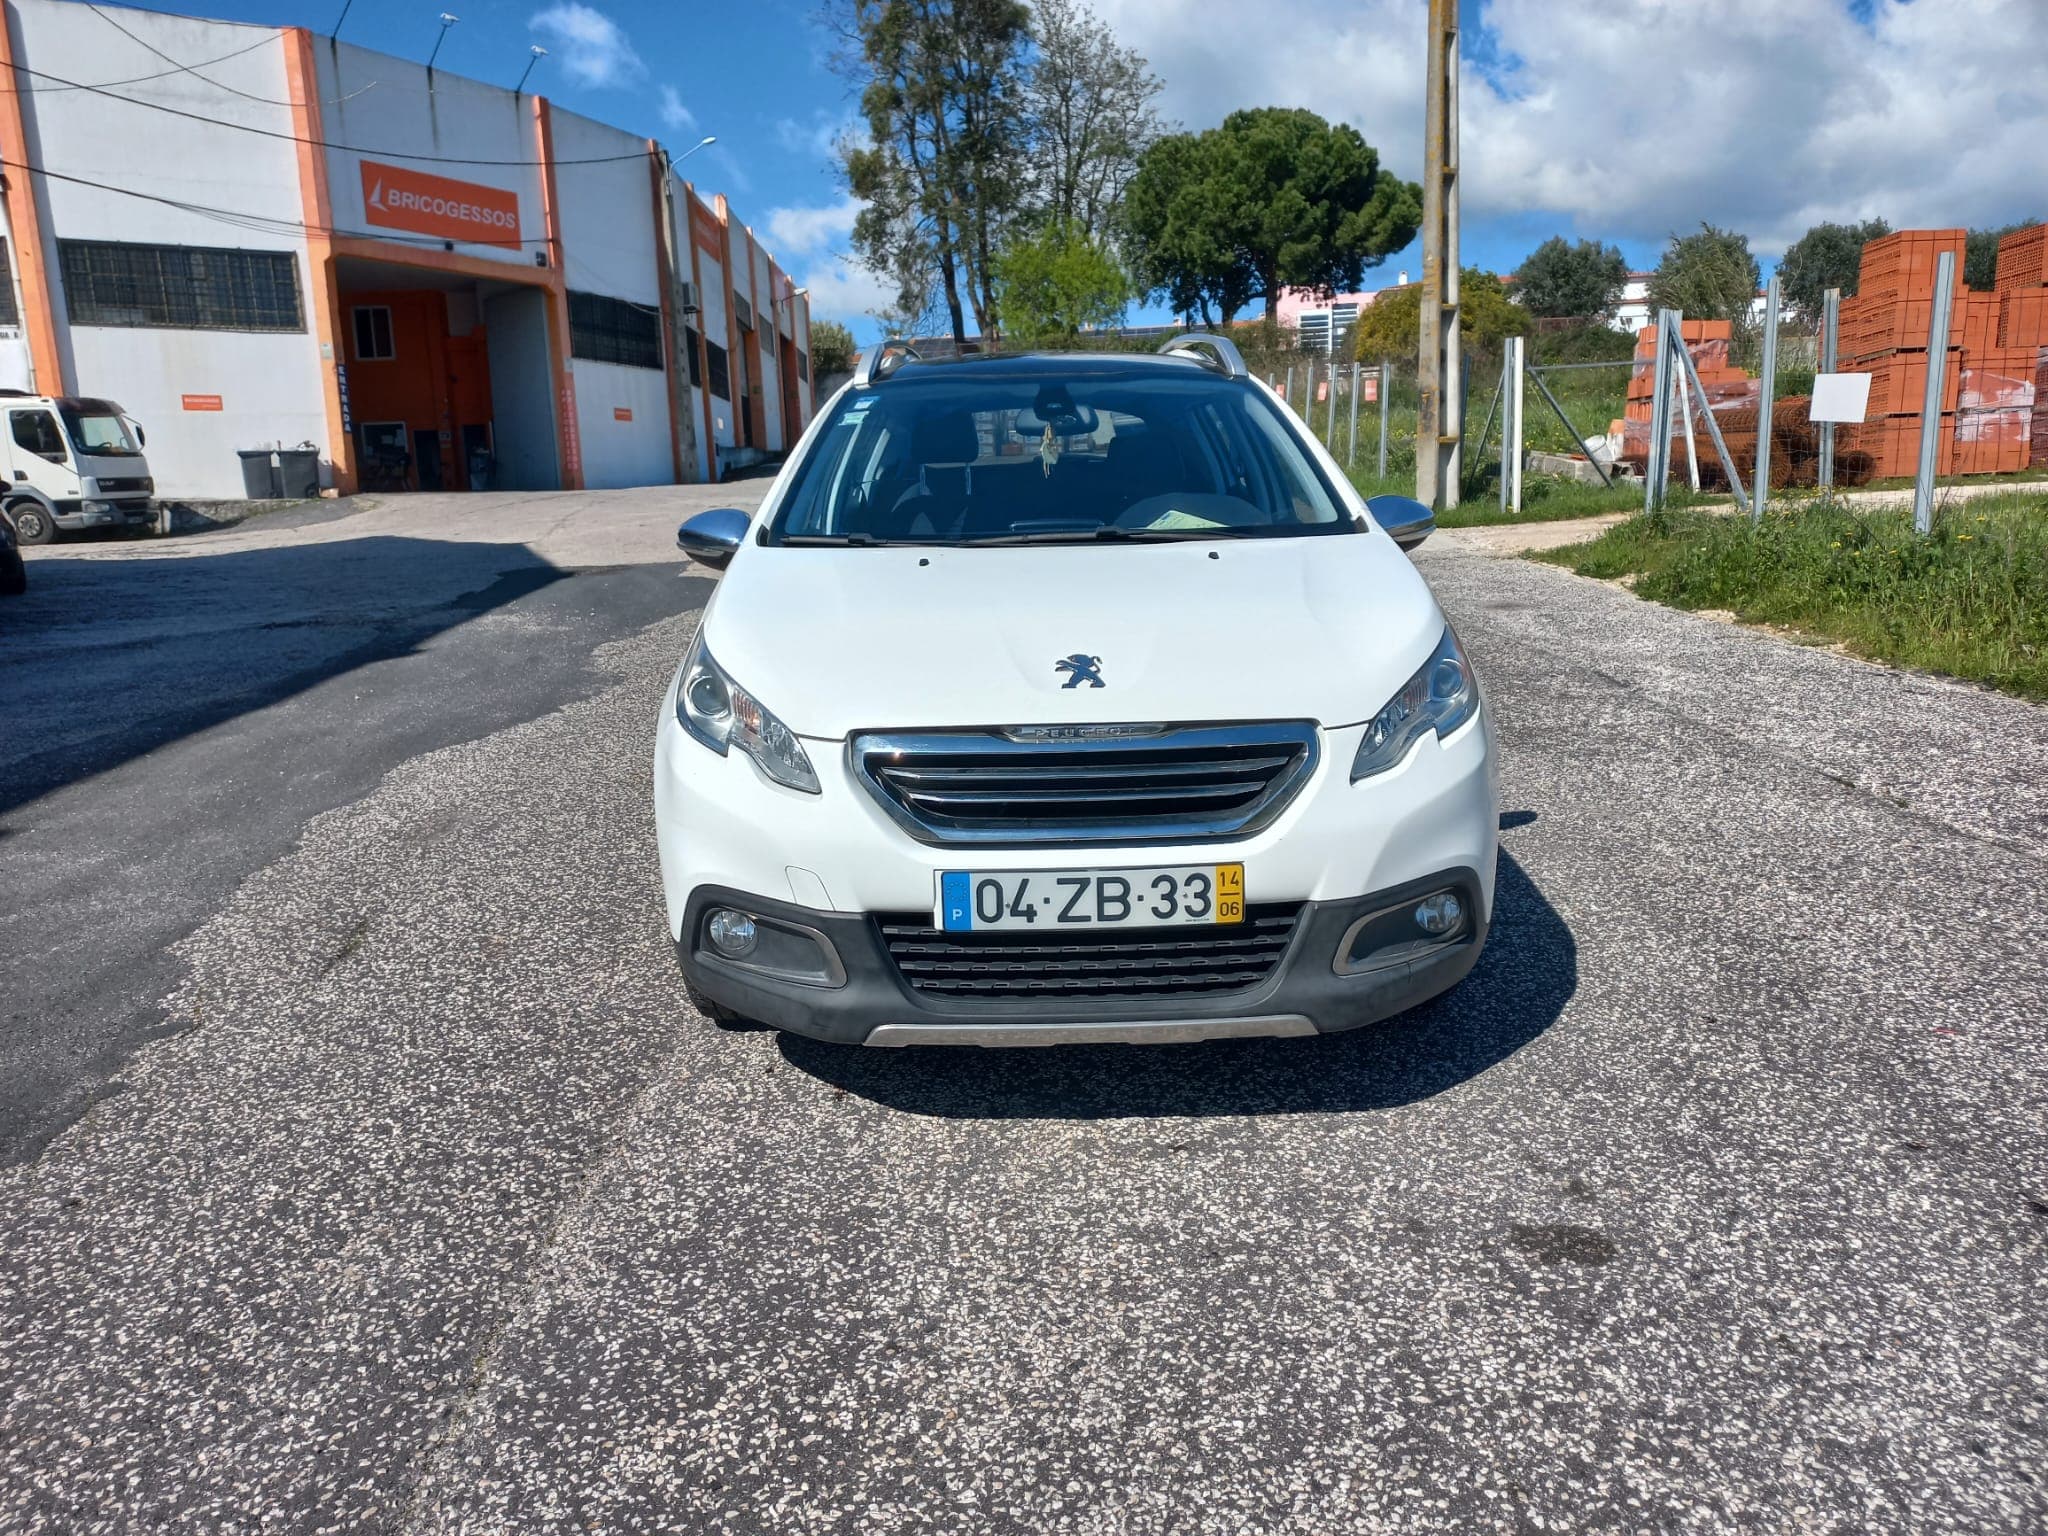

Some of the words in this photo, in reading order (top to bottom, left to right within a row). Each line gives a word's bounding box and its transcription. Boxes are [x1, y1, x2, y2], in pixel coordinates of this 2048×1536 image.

[387, 188, 516, 229] BRICOGESSOS
[338, 365, 353, 432] ENTRADA
[1219, 871, 1240, 887] 14
[952, 908, 963, 921] P
[1219, 901, 1240, 917] 06
